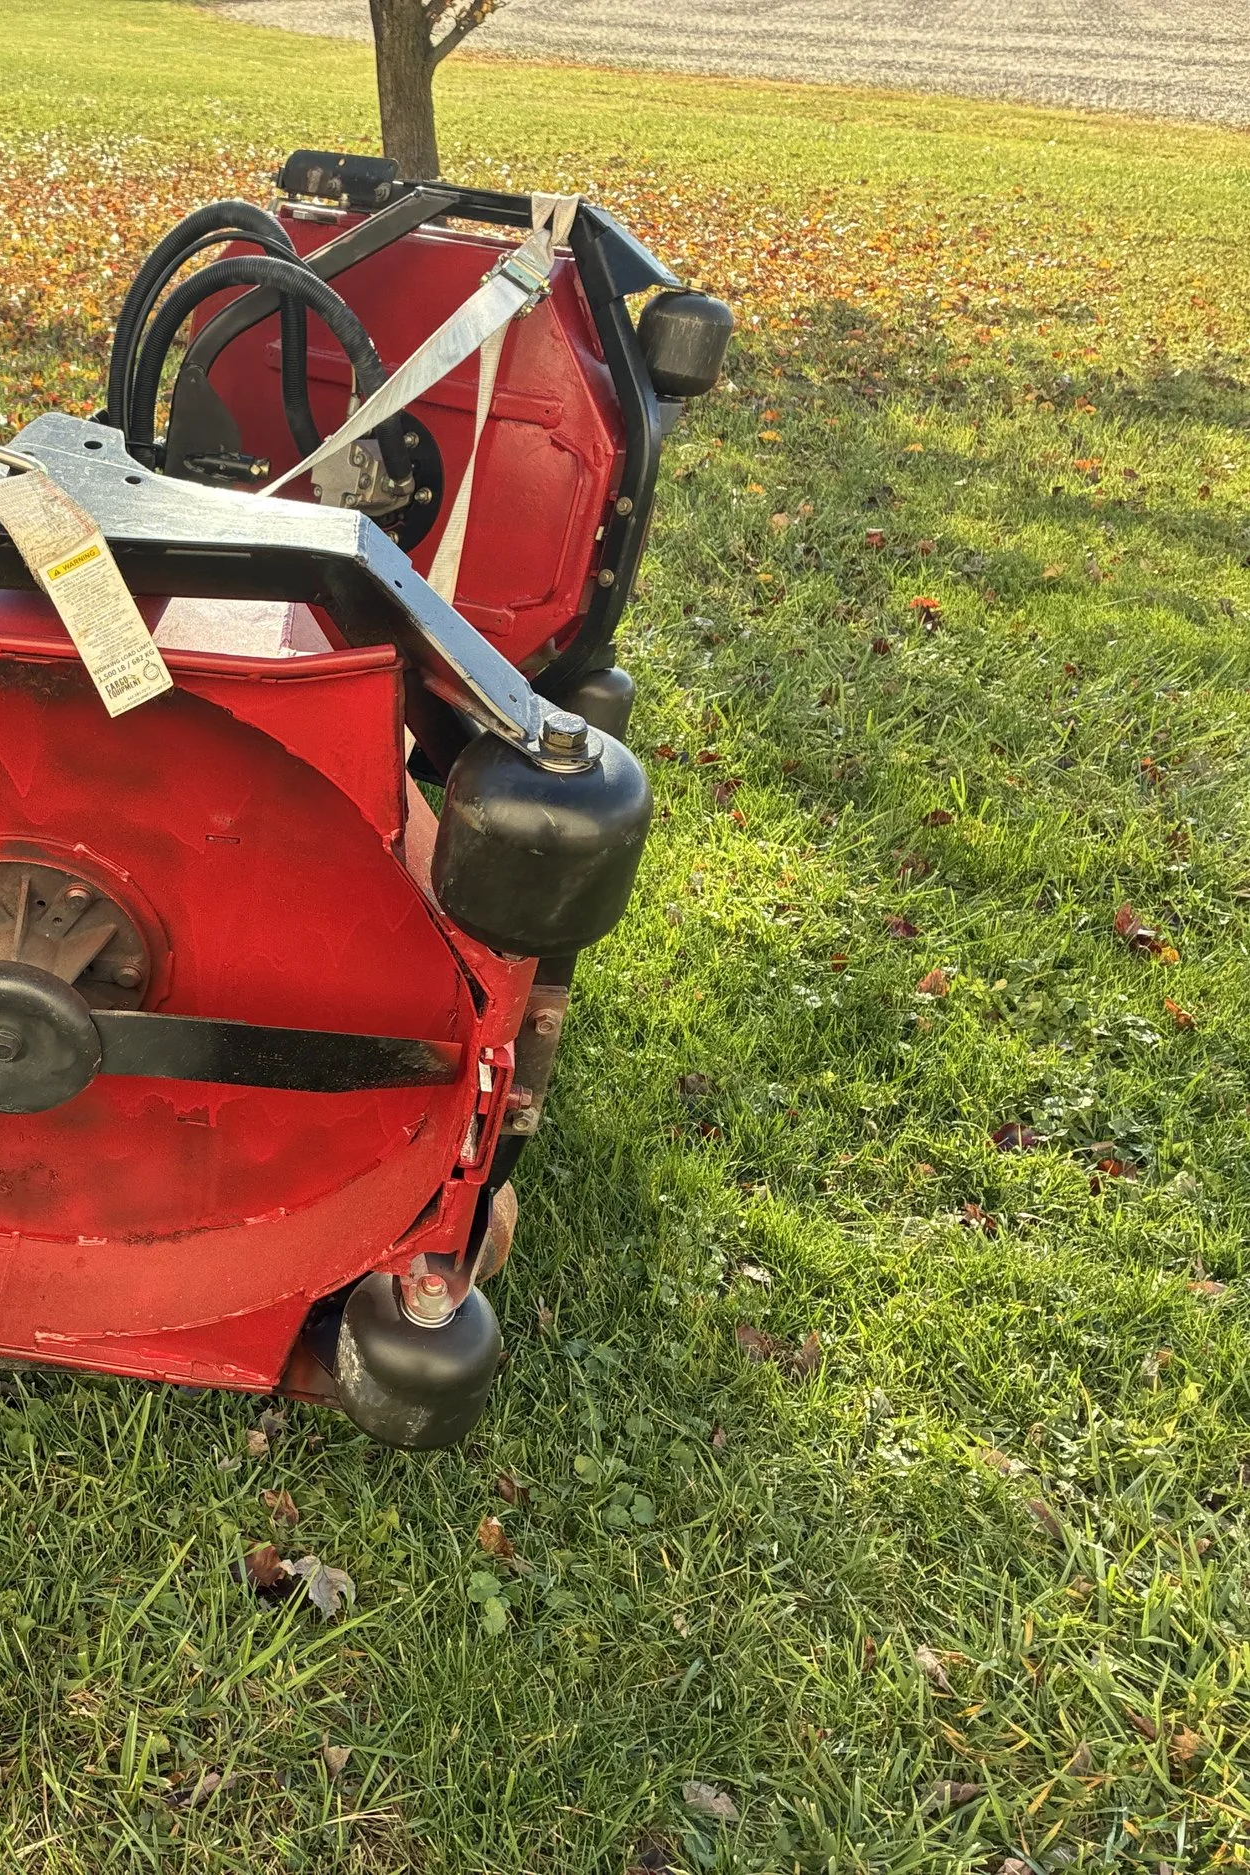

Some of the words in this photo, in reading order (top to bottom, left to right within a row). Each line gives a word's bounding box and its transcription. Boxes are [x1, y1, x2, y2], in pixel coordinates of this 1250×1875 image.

[62, 549, 96, 571] WARNING
[92, 658, 121, 676] WORKING
[120, 649, 137, 662] LOAD
[136, 641, 152, 654] LIMIT
[97, 669, 117, 684] 1,500
[117, 664, 127, 675] LB
[131, 654, 144, 666] 682
[145, 648, 155, 659] KG
[104, 675, 129, 693] CARGO
[108, 677, 142, 700] EQUIPMENT
